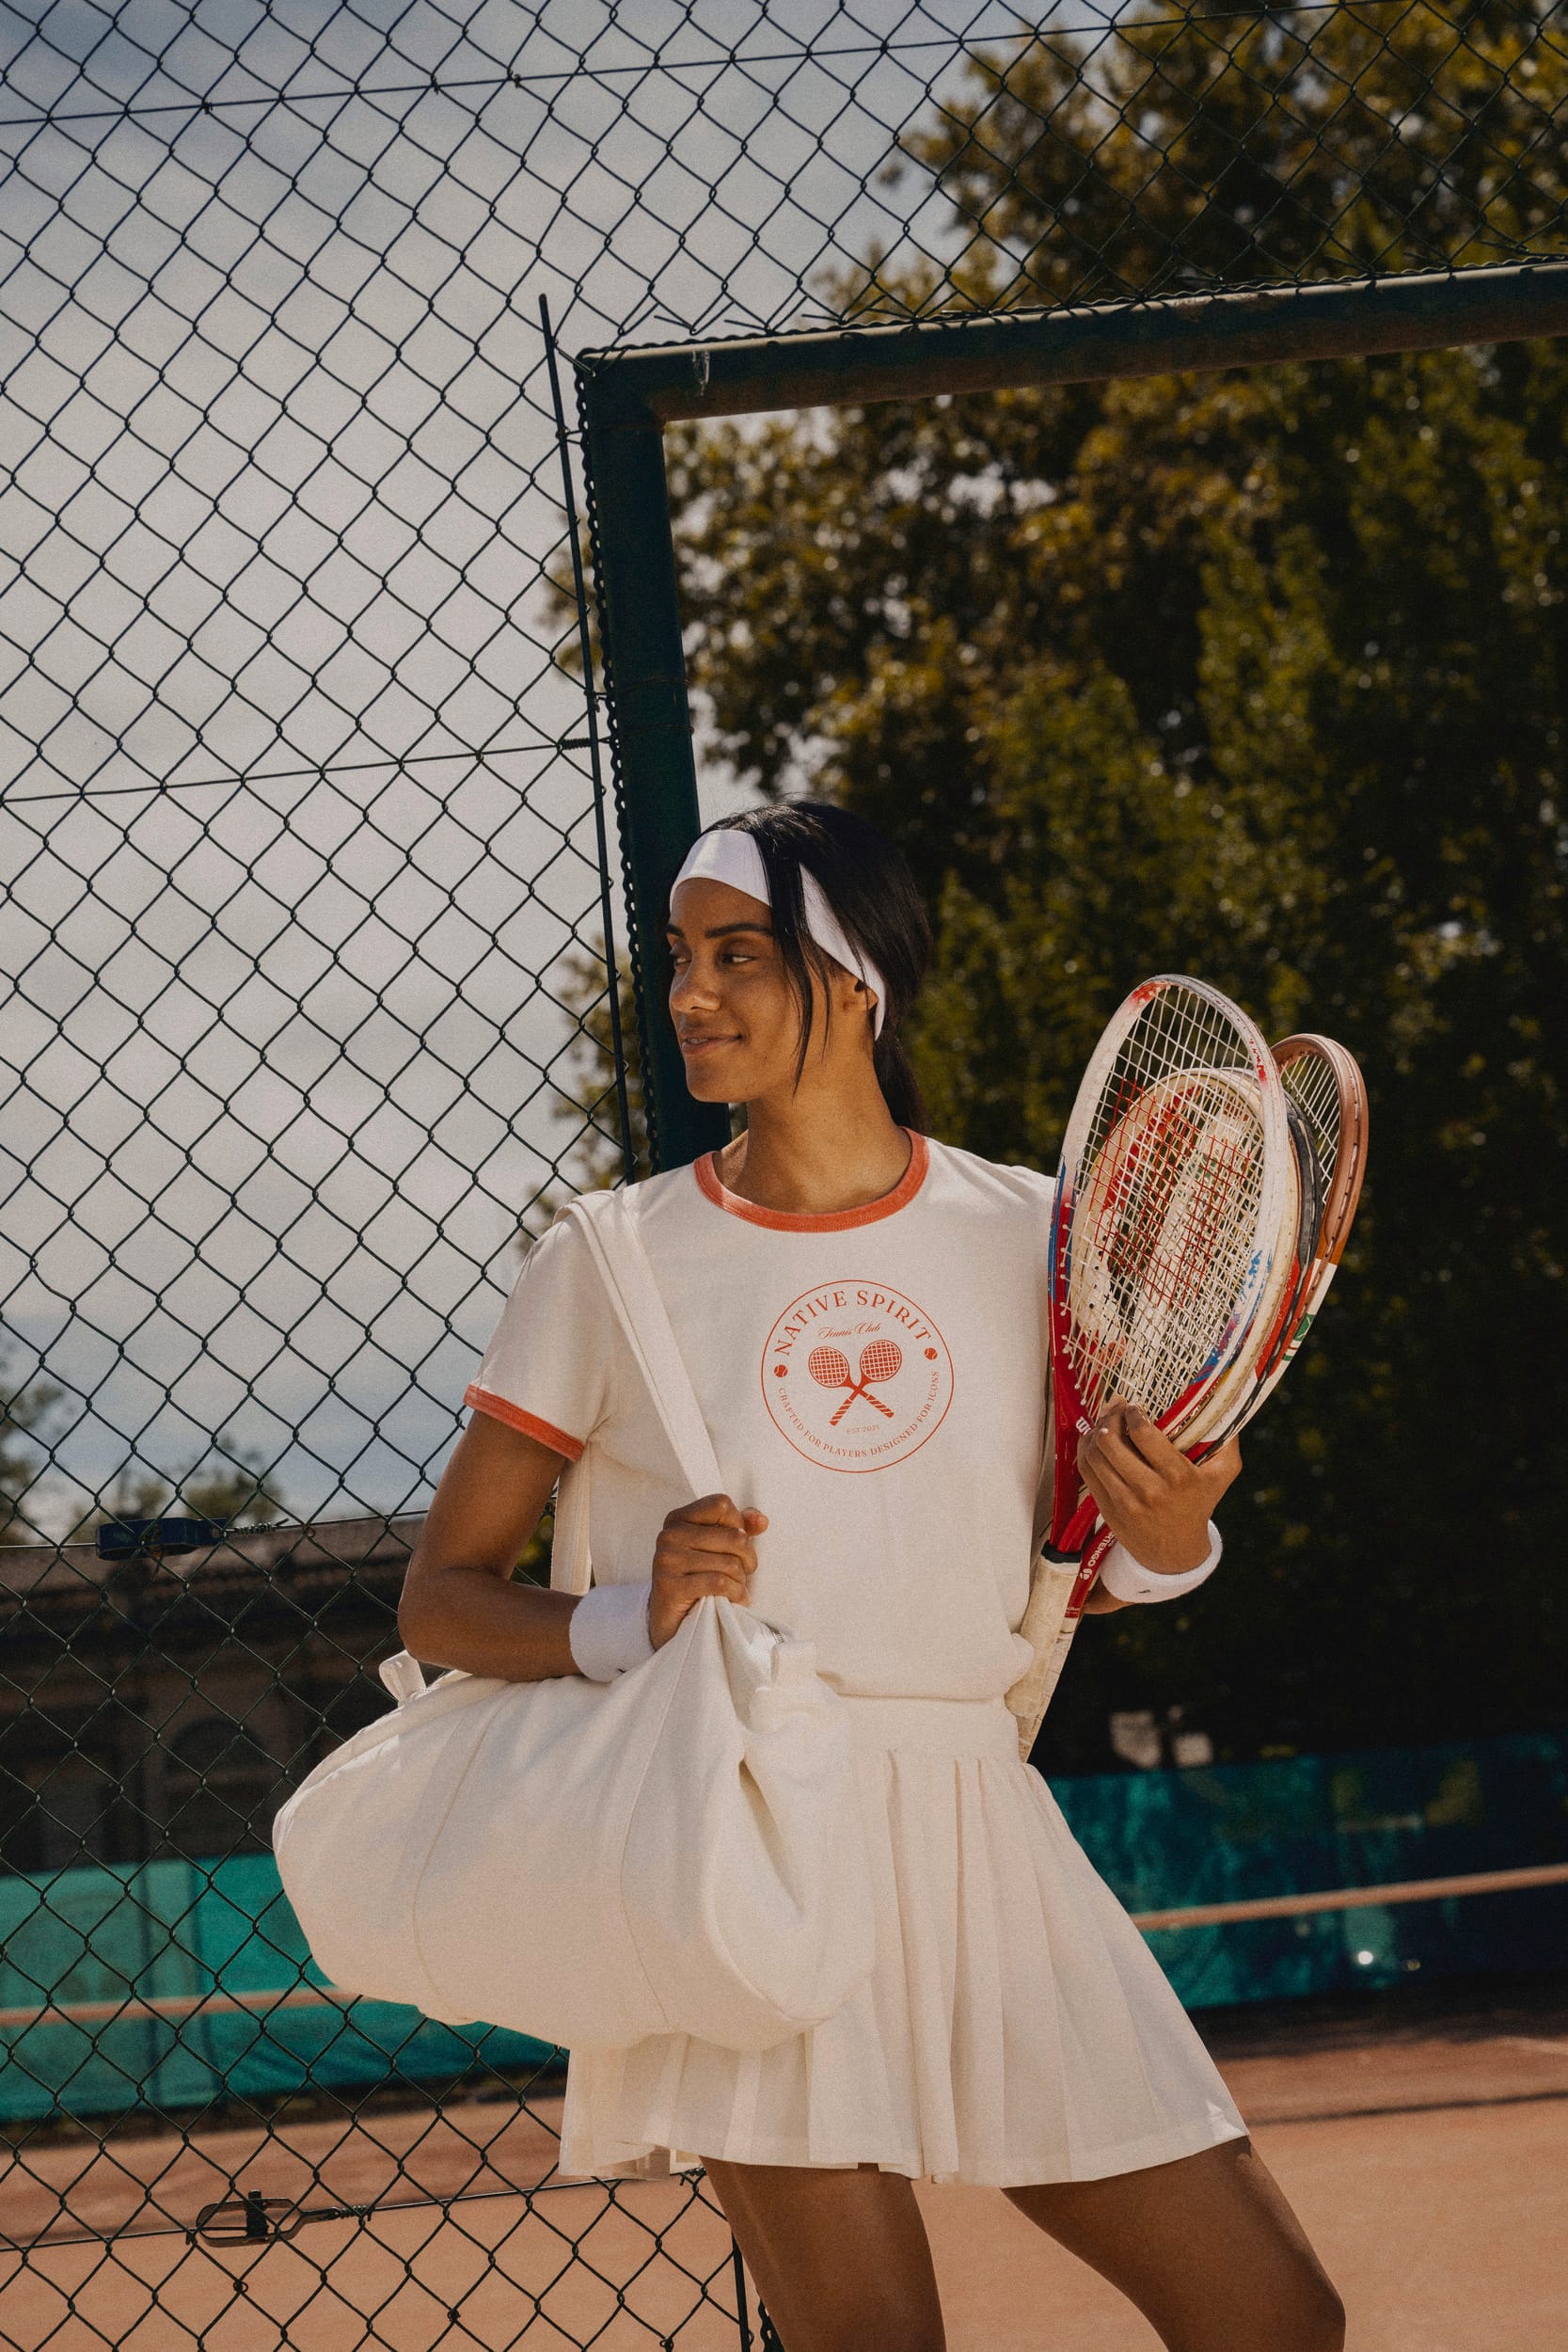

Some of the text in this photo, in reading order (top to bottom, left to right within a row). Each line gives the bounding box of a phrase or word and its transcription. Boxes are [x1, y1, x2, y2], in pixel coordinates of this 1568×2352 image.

[774, 1290, 931, 1356] NATIVE SPIRIT
[818, 1322, 881, 1340] Tennis Club
[778, 1370, 939, 1457] CRAFTED FOR PLAYERS DESIGNED FOR ICONS
[1087, 1531, 1116, 1566] RTENGO
